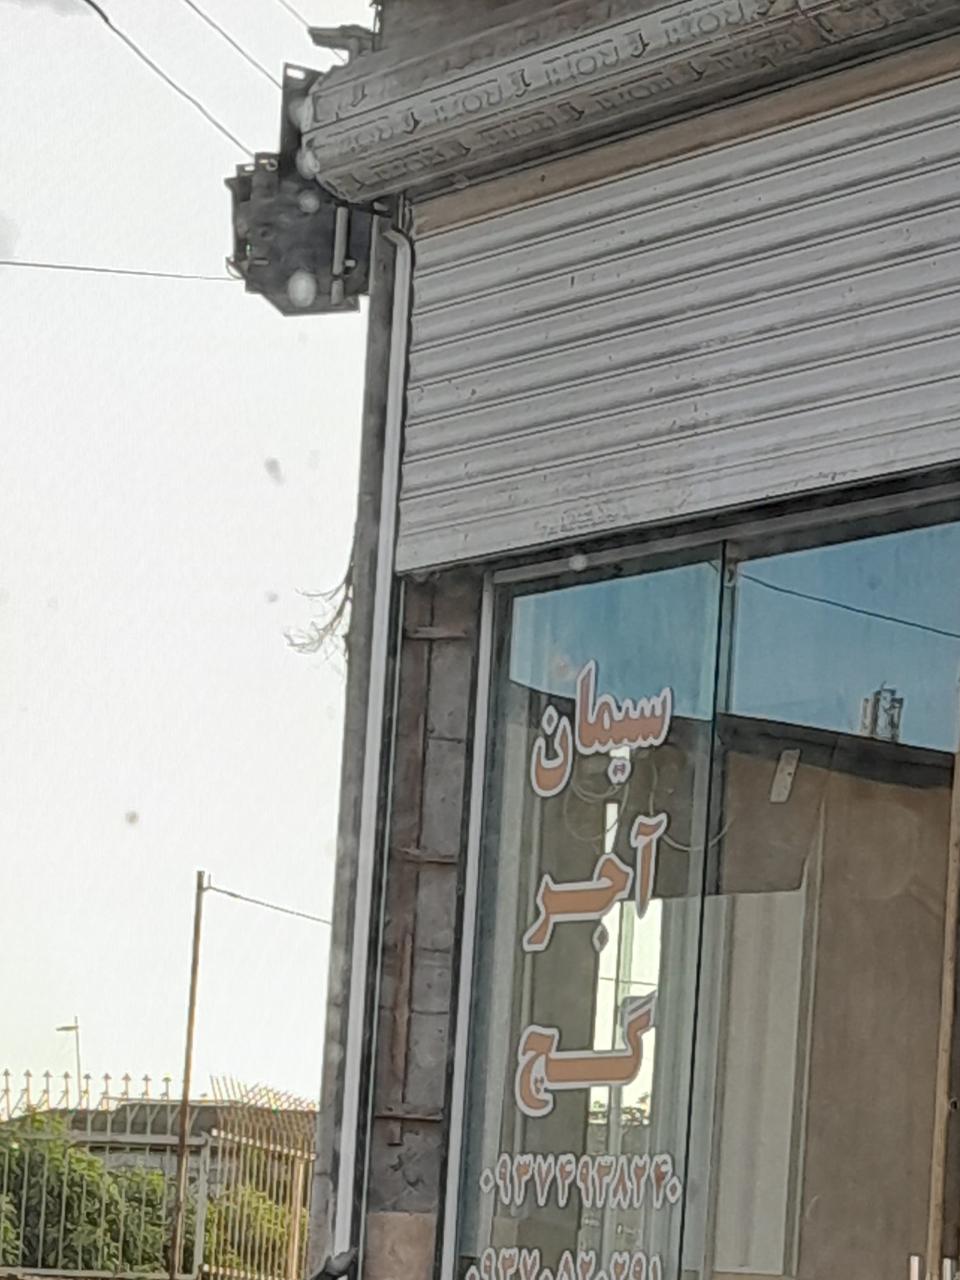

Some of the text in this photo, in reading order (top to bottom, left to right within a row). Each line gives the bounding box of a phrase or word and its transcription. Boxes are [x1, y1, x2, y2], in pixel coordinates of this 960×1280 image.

[532, 659, 672, 797] سیمان
[522, 812, 668, 952] آجر
[514, 990, 657, 1118] گچ
